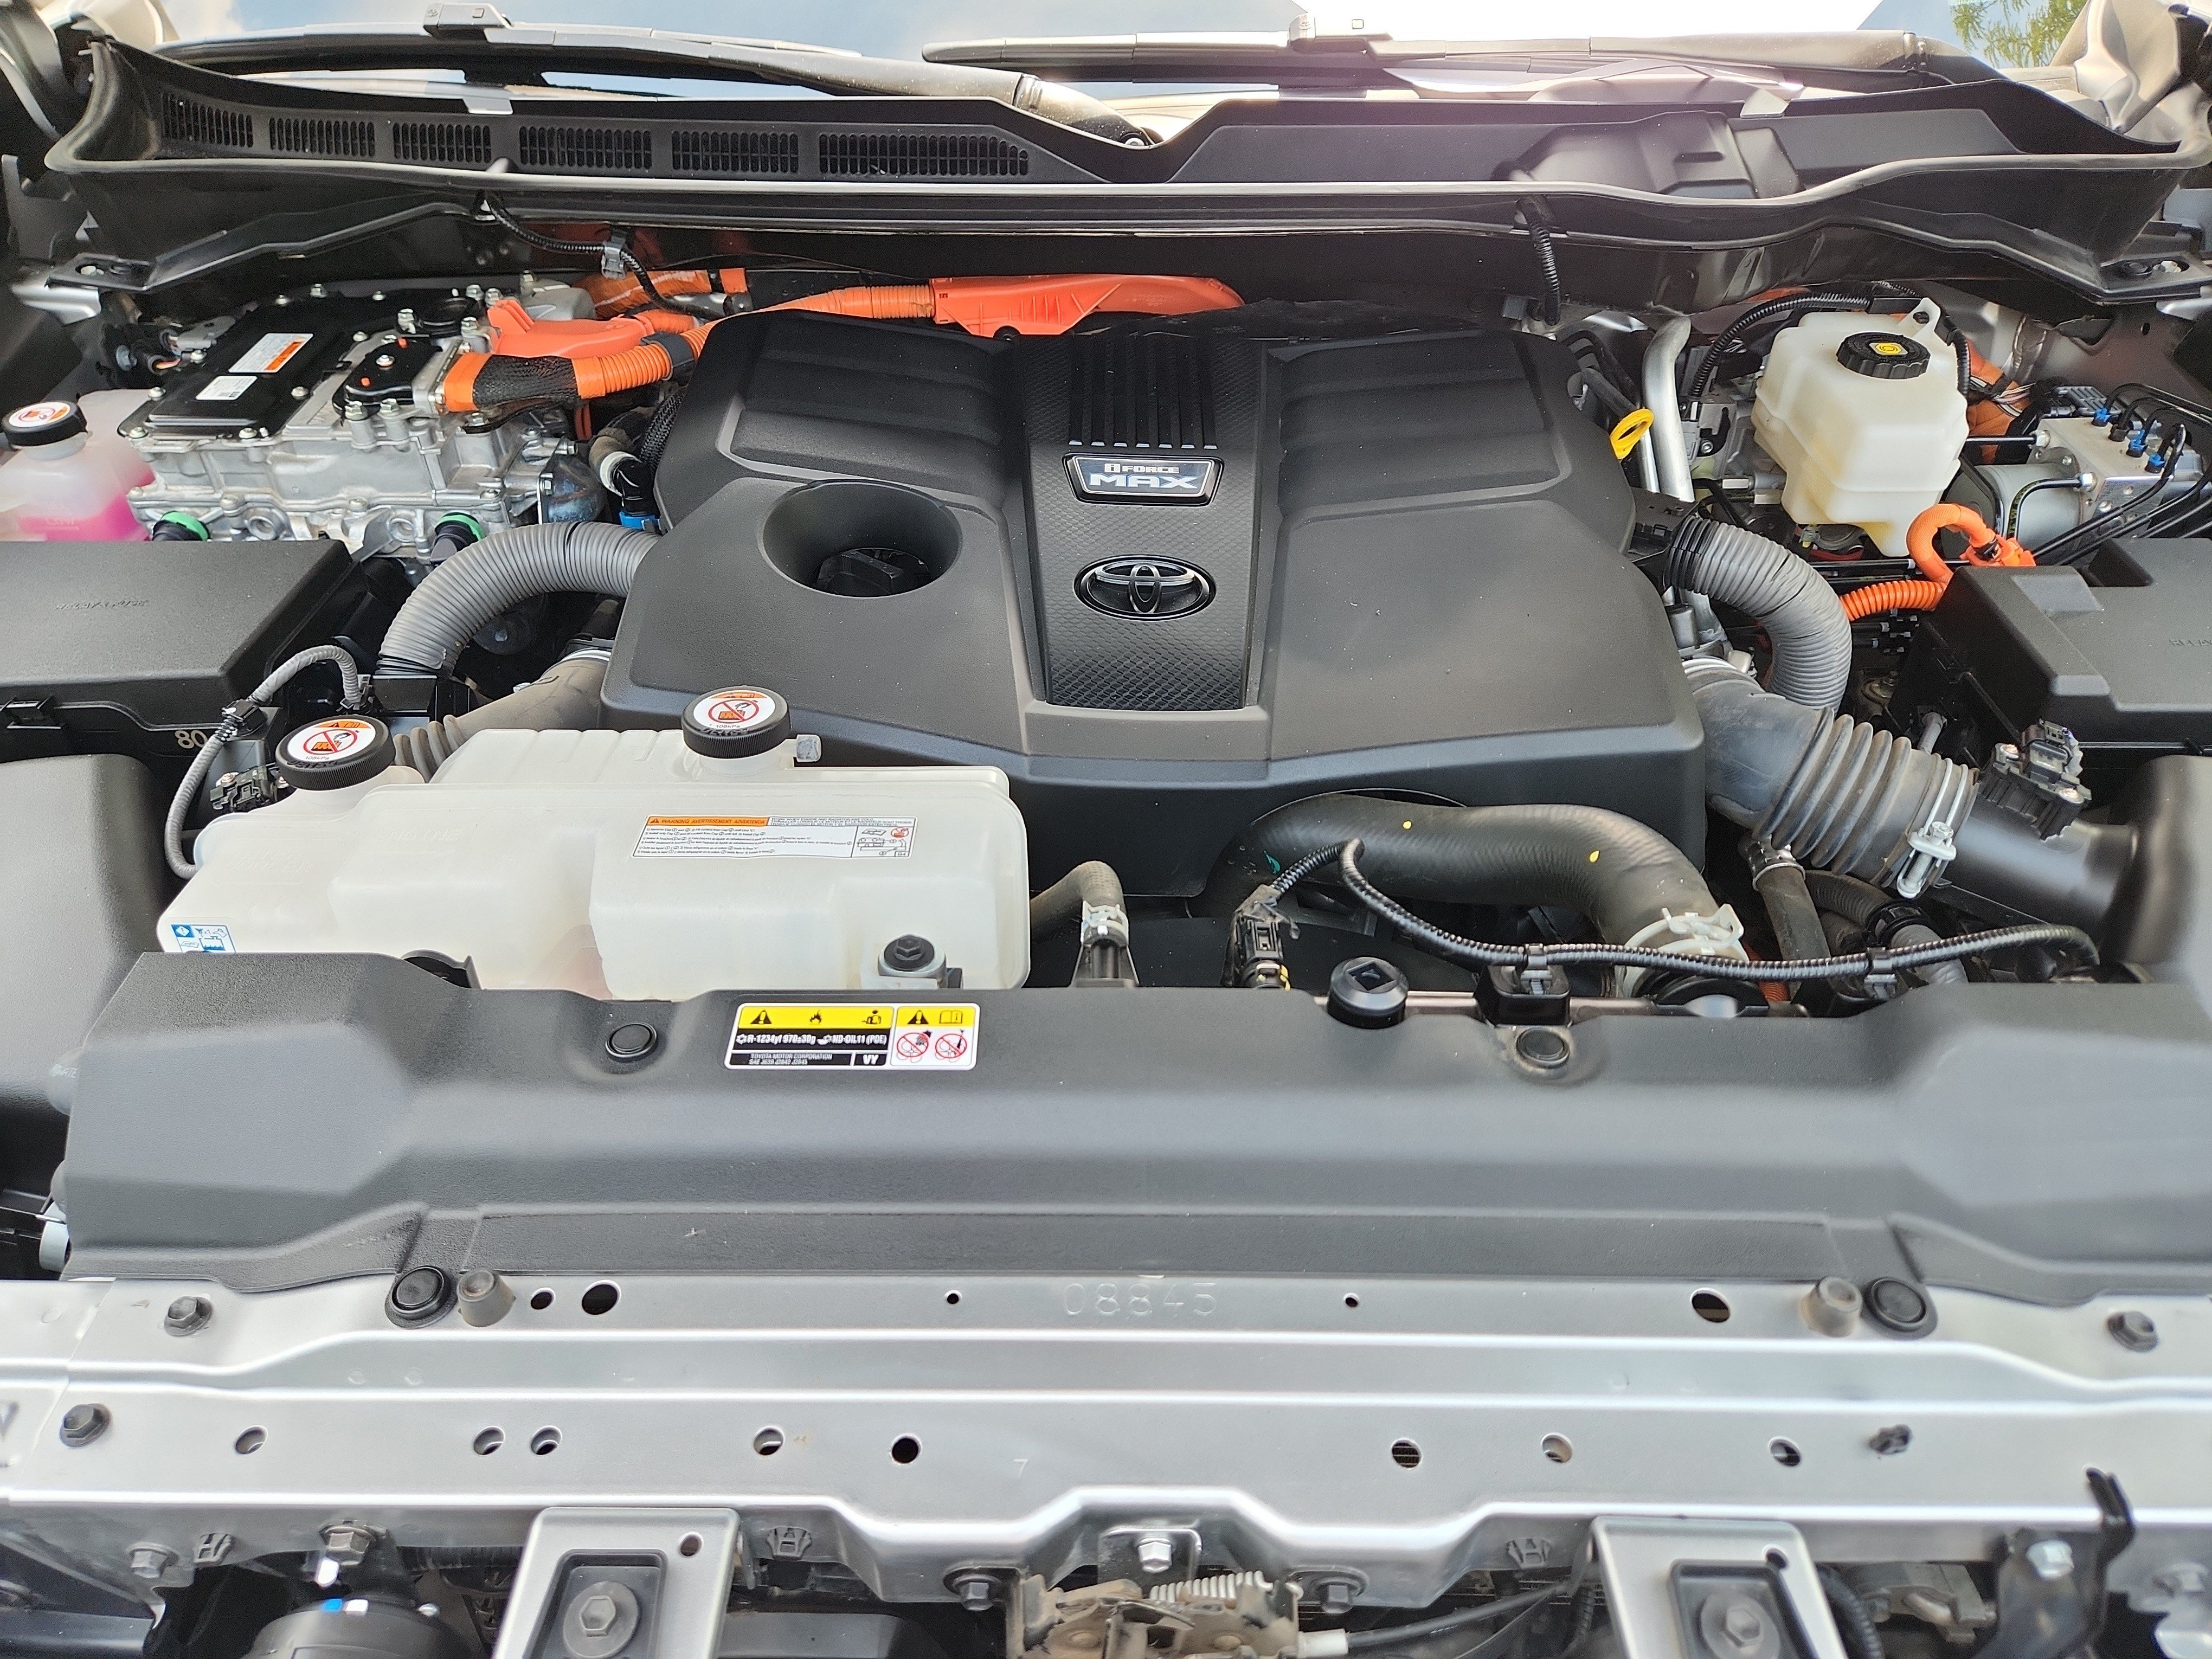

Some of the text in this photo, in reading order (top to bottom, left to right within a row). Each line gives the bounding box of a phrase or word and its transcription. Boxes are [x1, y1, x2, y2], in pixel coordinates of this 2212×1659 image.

[1122, 465, 1180, 474] FORCE
[1089, 473, 1198, 489] MAX
[782, 1034, 816, 1045] 970±30g
[866, 1034, 888, 1045] (POE)
[863, 1054, 879, 1065] VY
[1063, 1282, 1218, 1316] 08845
